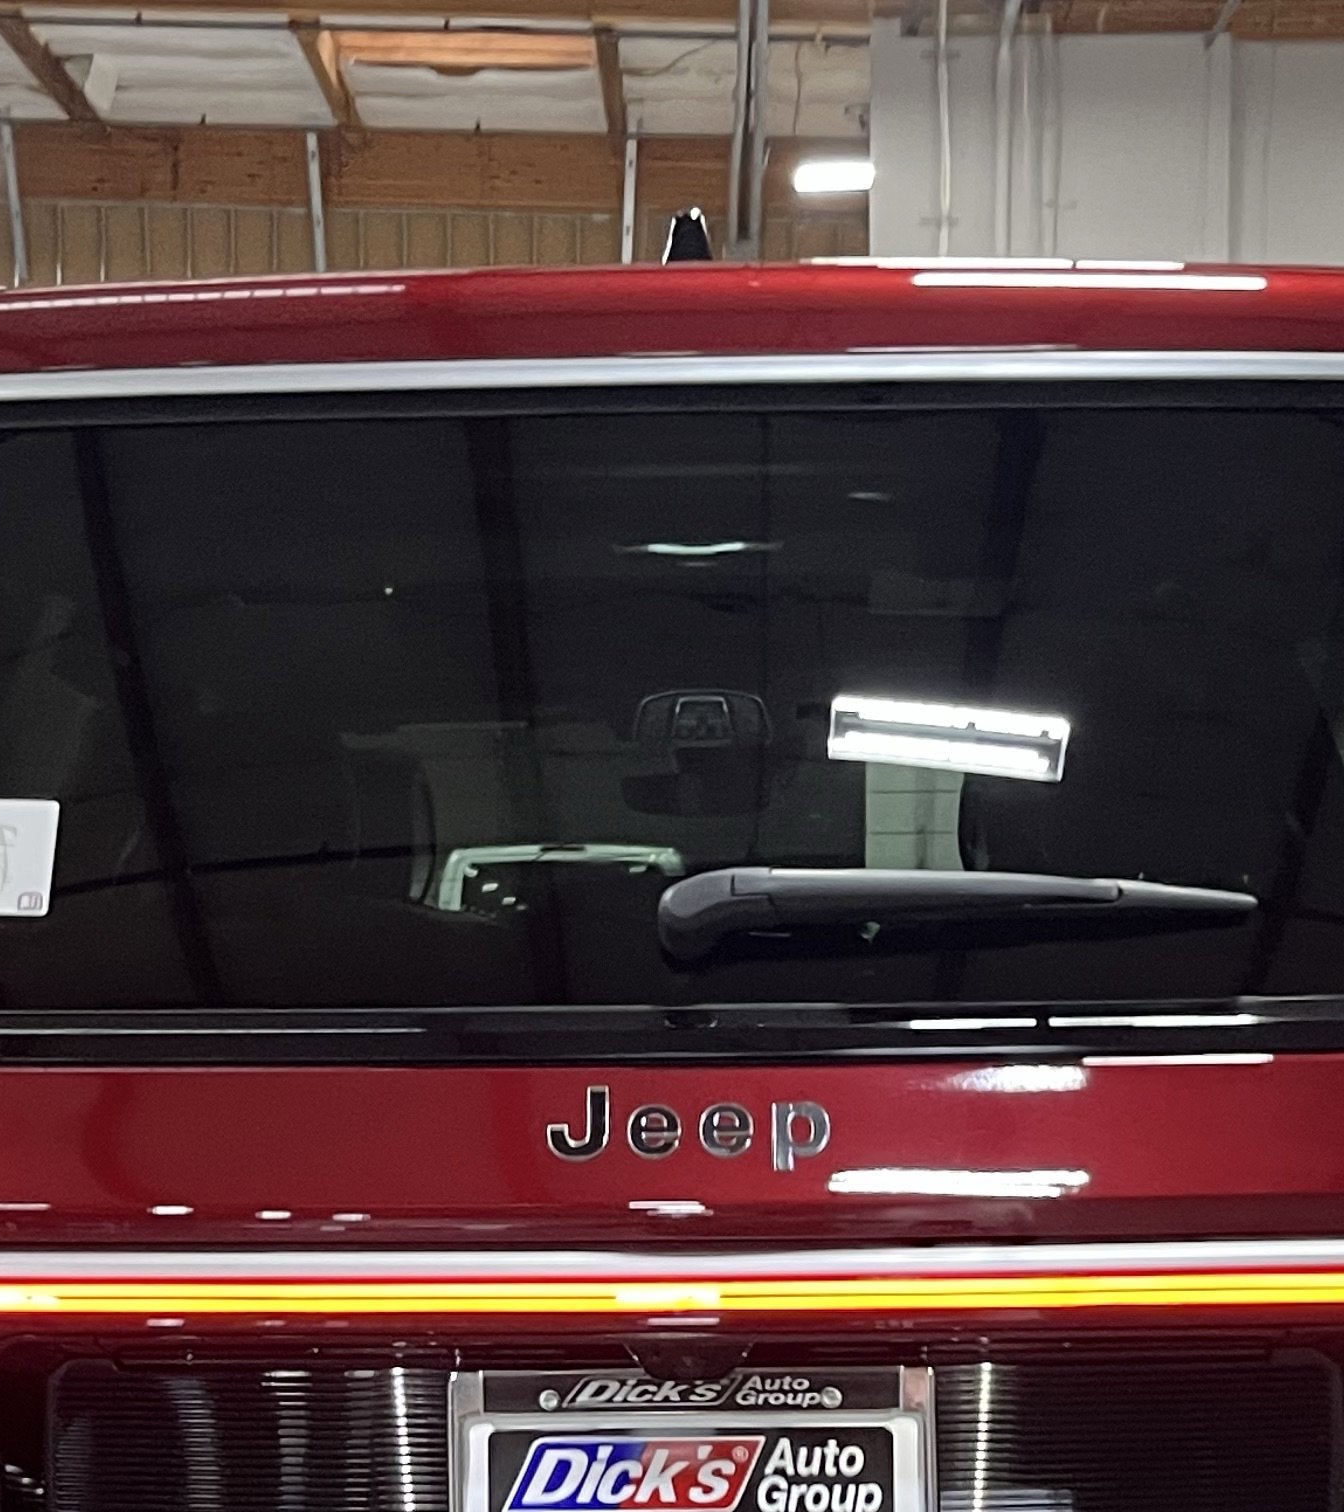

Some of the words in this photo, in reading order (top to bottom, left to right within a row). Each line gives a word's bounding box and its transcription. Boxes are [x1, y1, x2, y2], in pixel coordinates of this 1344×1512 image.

[546, 1085, 831, 1171] Jeep
[575, 1379, 722, 1402] Dick's
[735, 1390, 822, 1408] Group
[742, 1376, 810, 1391] Auto
[764, 1438, 865, 1478] Auto
[521, 1446, 736, 1506] Dick's
